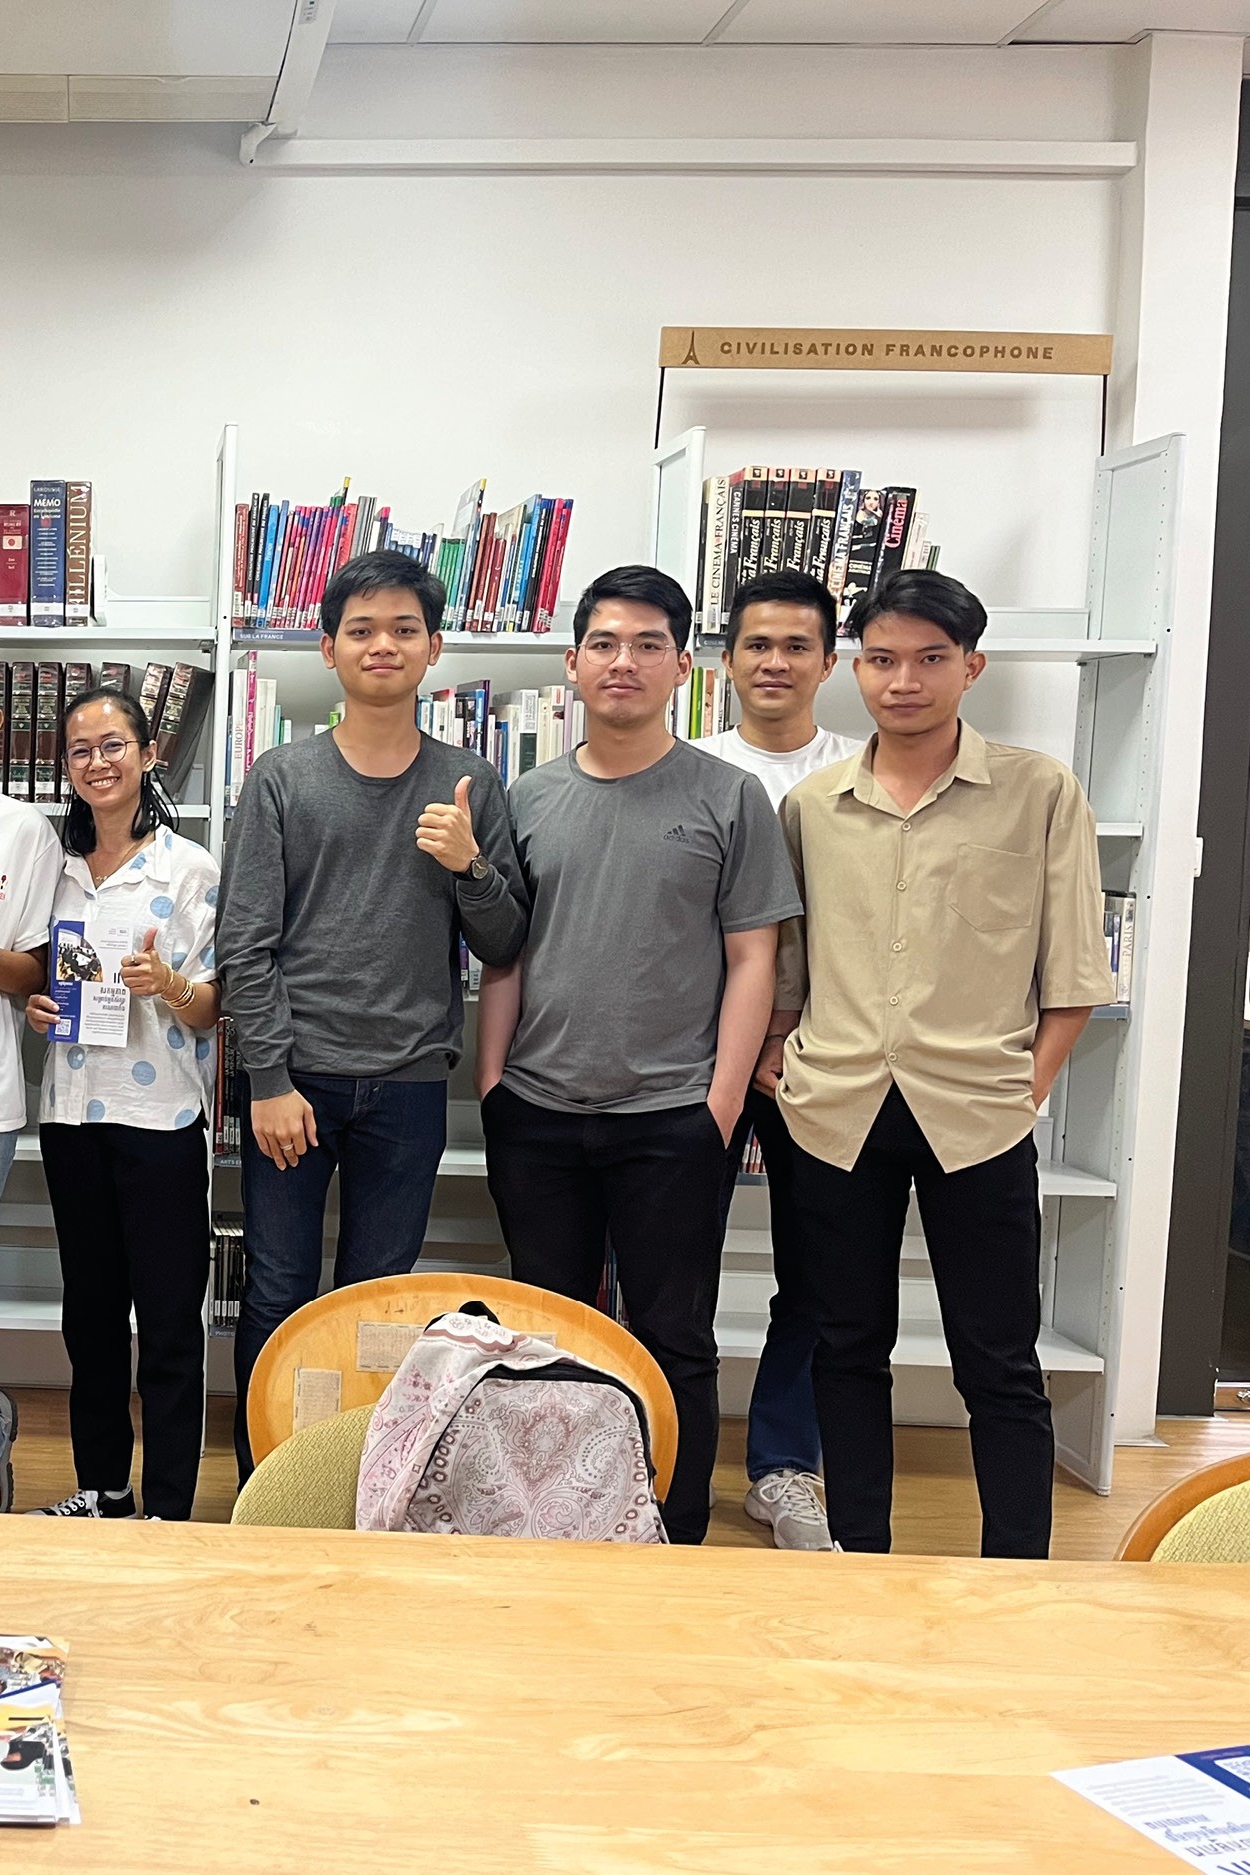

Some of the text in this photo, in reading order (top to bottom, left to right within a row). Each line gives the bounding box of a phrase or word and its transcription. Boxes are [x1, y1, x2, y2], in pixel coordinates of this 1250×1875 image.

[720, 341, 1055, 360] CIVILISATION FRANCOPHONE
[715, 479, 726, 538] FRANÇAIS
[732, 491, 742, 523] CANNES
[743, 518, 760, 569] Français
[764, 518, 782, 571] Français
[786, 520, 805, 571] Français
[812, 518, 831, 568] Français
[711, 592, 720, 605] LE
[234, 720, 243, 759] EUROPE
